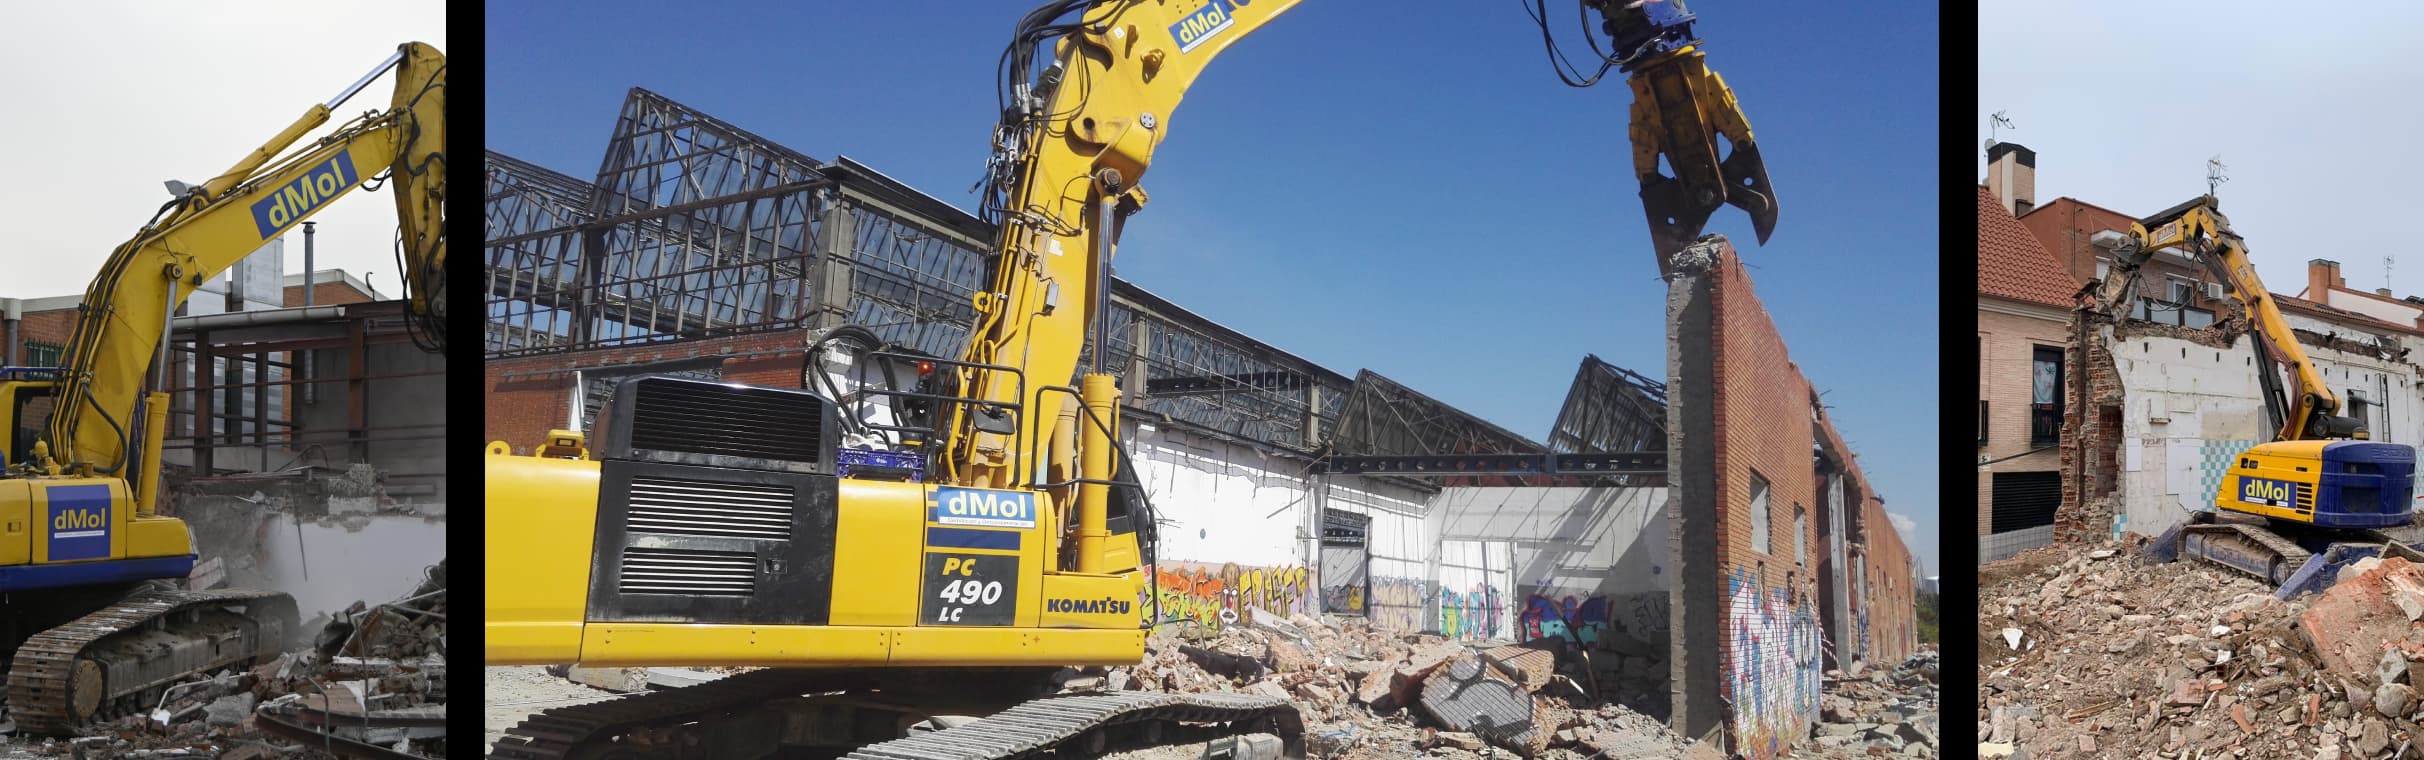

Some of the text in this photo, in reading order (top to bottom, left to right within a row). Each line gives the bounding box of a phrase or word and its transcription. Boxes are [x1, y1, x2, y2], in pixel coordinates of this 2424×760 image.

[1179, 2, 1226, 43] dMol
[269, 158, 346, 228] dMol
[2245, 479, 2289, 501] dMol
[948, 491, 1026, 518] dMol
[54, 507, 106, 530] dMol
[942, 557, 977, 577] PC
[940, 579, 1003, 605] 490
[938, 606, 963, 622] LC
[1047, 596, 1130, 614] KOMATSU
